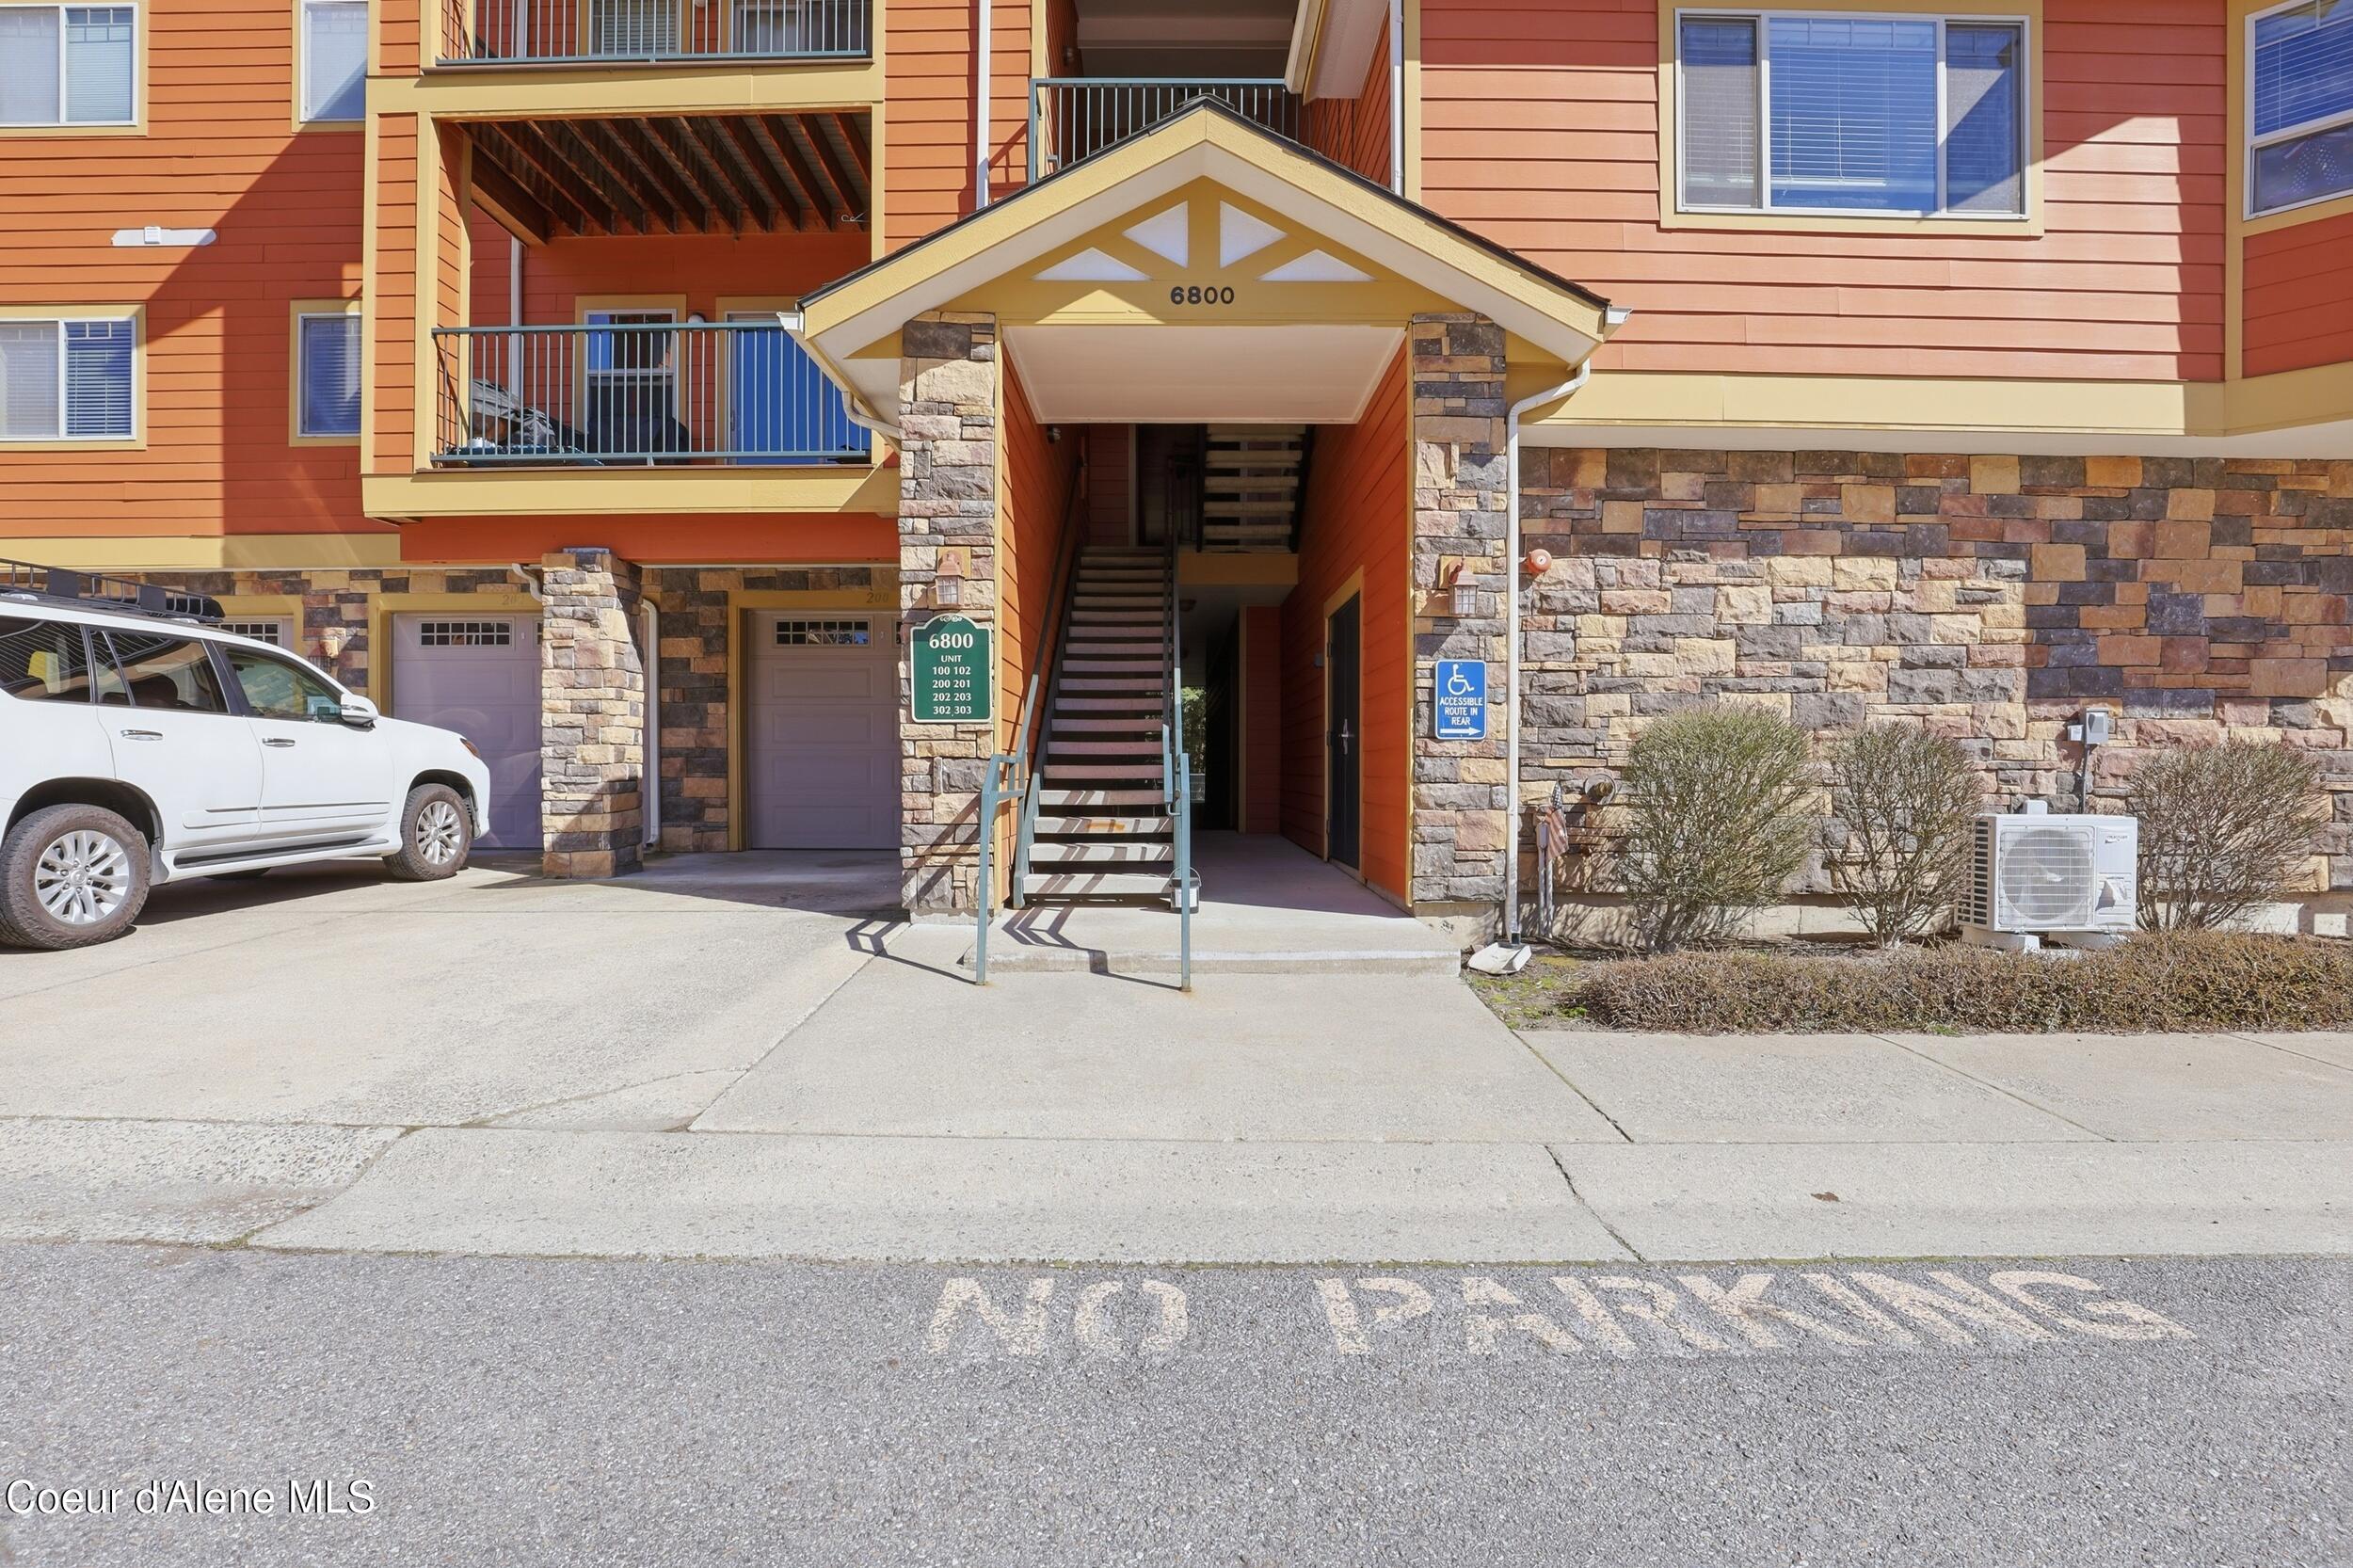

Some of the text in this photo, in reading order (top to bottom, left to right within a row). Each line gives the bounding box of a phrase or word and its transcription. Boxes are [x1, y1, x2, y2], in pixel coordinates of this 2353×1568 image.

[1170, 285, 1235, 305] 6800
[929, 632, 973, 648] 6800
[933, 666, 971, 676] 100 102
[933, 680, 971, 689] 200 201
[933, 693, 971, 702] 202 203
[1440, 696, 1483, 706] ACCESSIBLE
[933, 706, 971, 715] 302 303
[1445, 707, 1478, 716] ROUTE IN
[1451, 716, 1471, 726] REAR
[925, 1271, 2193, 1356] NO PARKING
